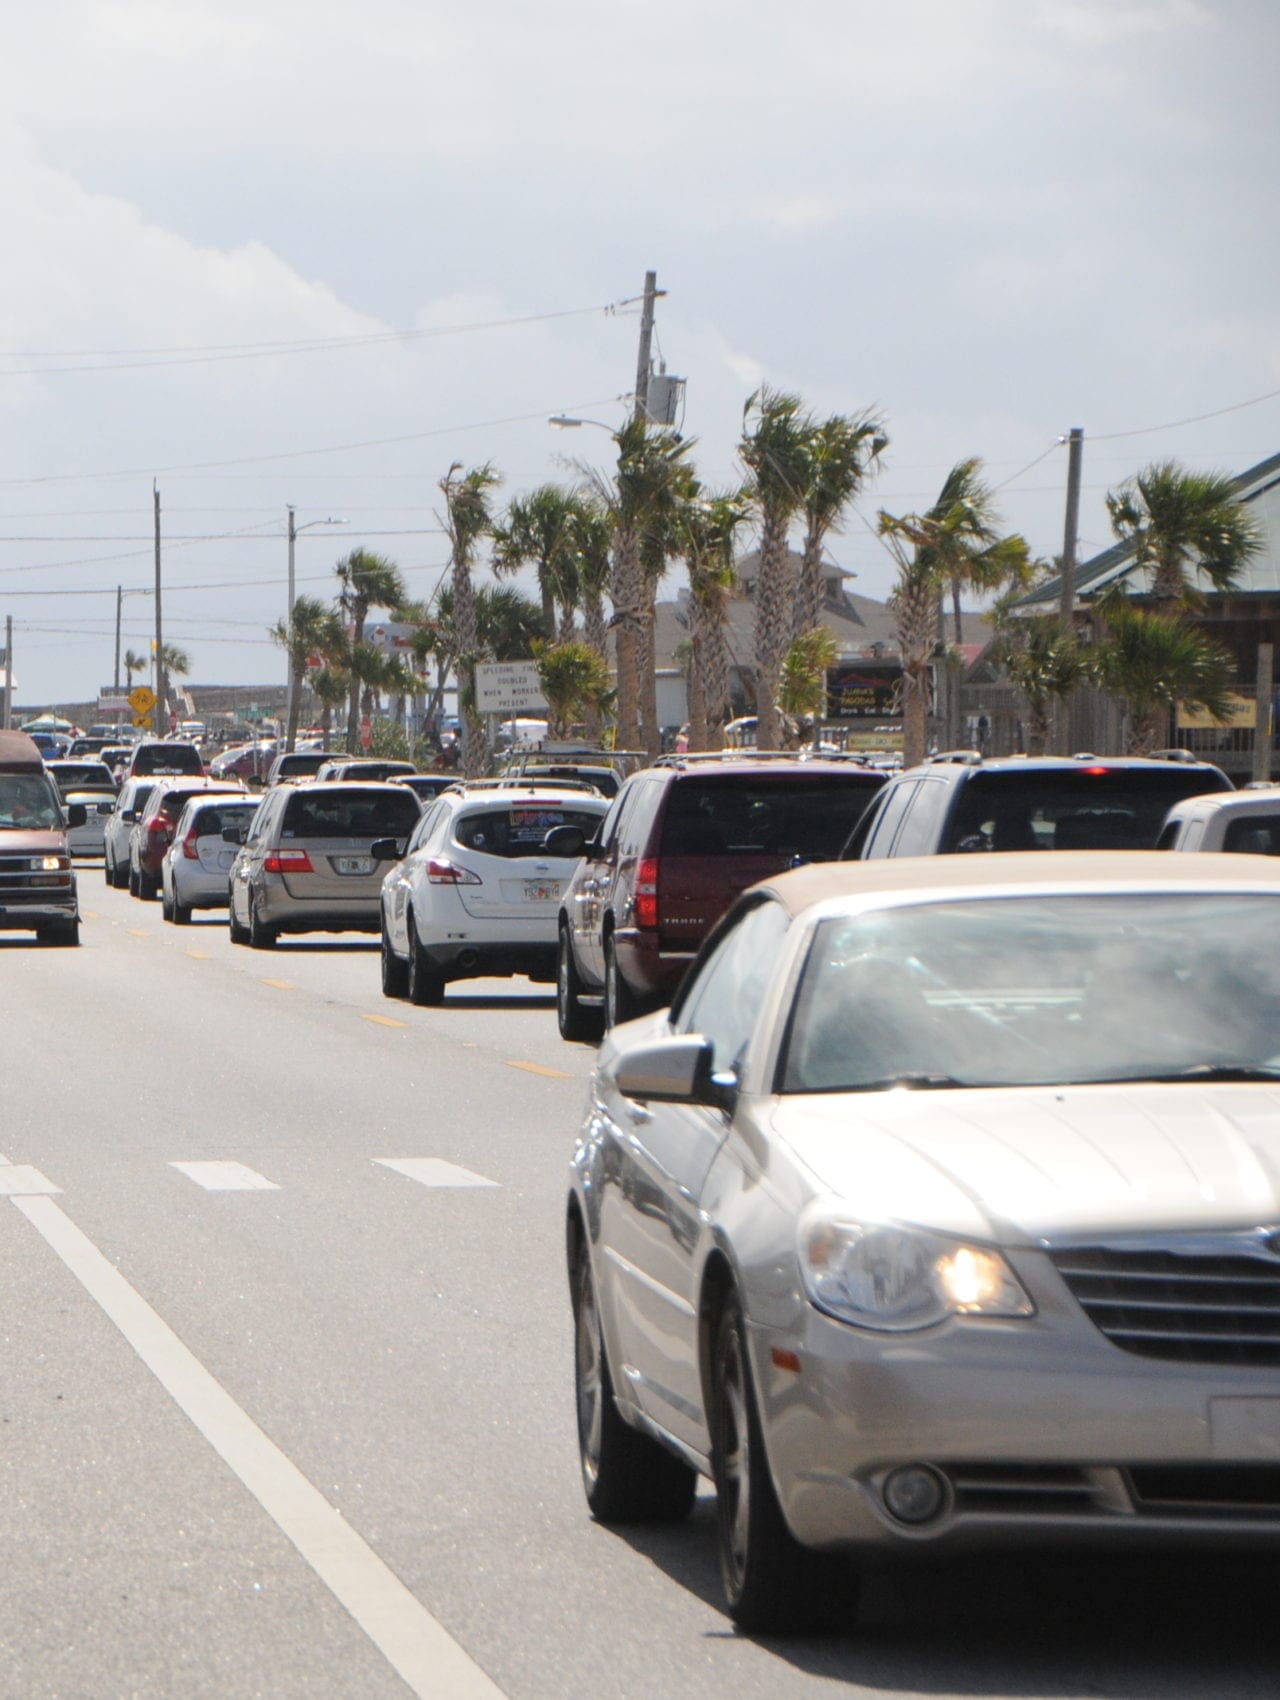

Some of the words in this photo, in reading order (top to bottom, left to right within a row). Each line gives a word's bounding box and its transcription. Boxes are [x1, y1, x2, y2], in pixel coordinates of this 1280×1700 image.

[483, 665, 513, 674] SPEEDING
[497, 676, 527, 684] DOUBLED
[483, 688, 502, 696] WHEN
[499, 698, 528, 707] PRESENT
